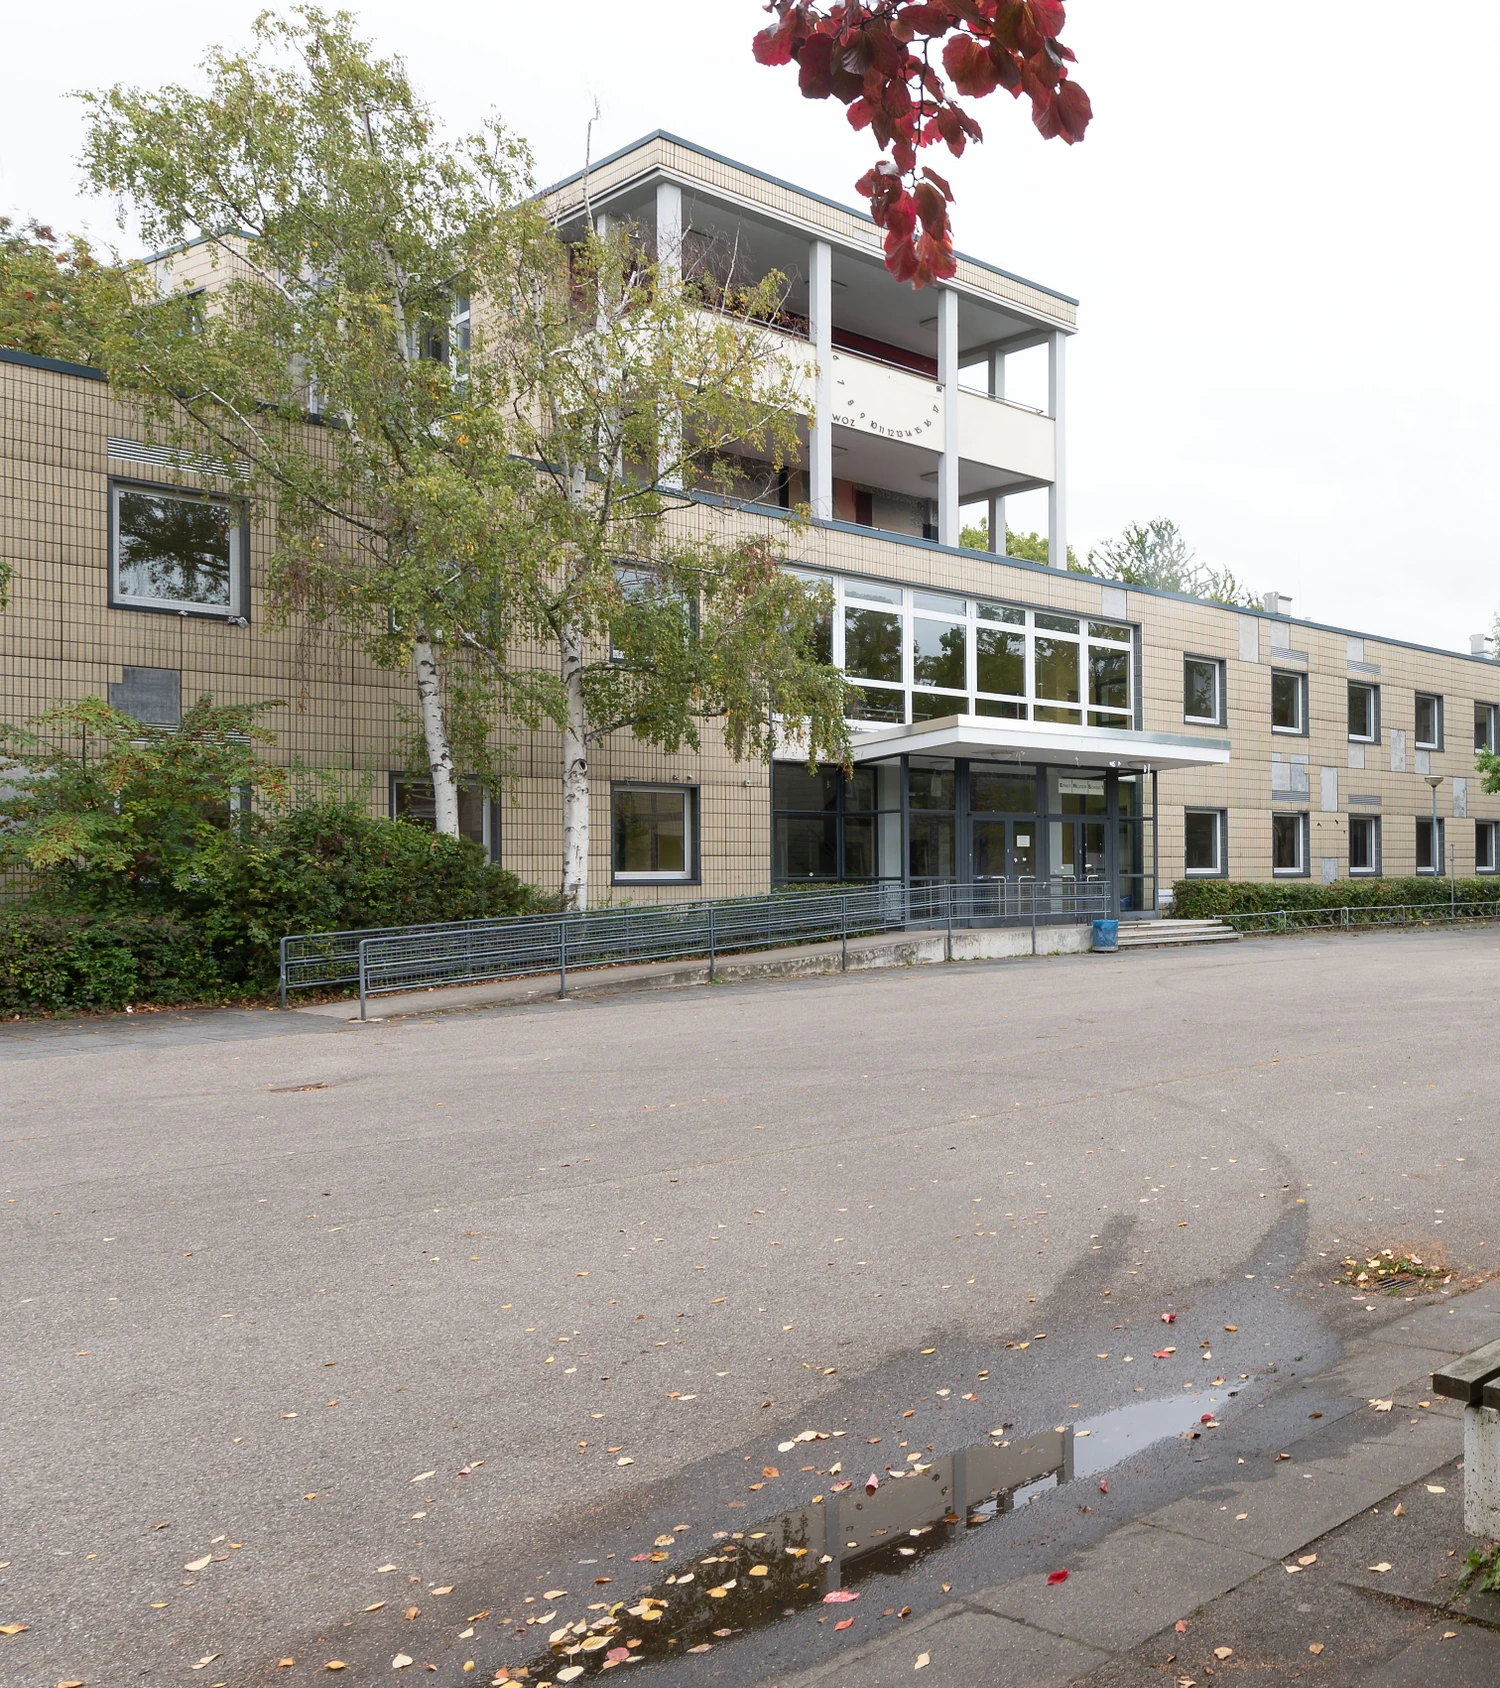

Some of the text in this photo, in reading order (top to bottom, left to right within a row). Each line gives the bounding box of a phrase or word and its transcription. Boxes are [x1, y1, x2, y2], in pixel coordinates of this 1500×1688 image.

[832, 413, 856, 427] WOZ
[870, 420, 878, 430] 10
[879, 425, 885, 434] 11
[887, 428, 895, 437] 12
[896, 430, 904, 438] 13
[914, 426, 922, 434] 15
[923, 419, 932, 427] 16
[932, 404, 940, 414] 17
